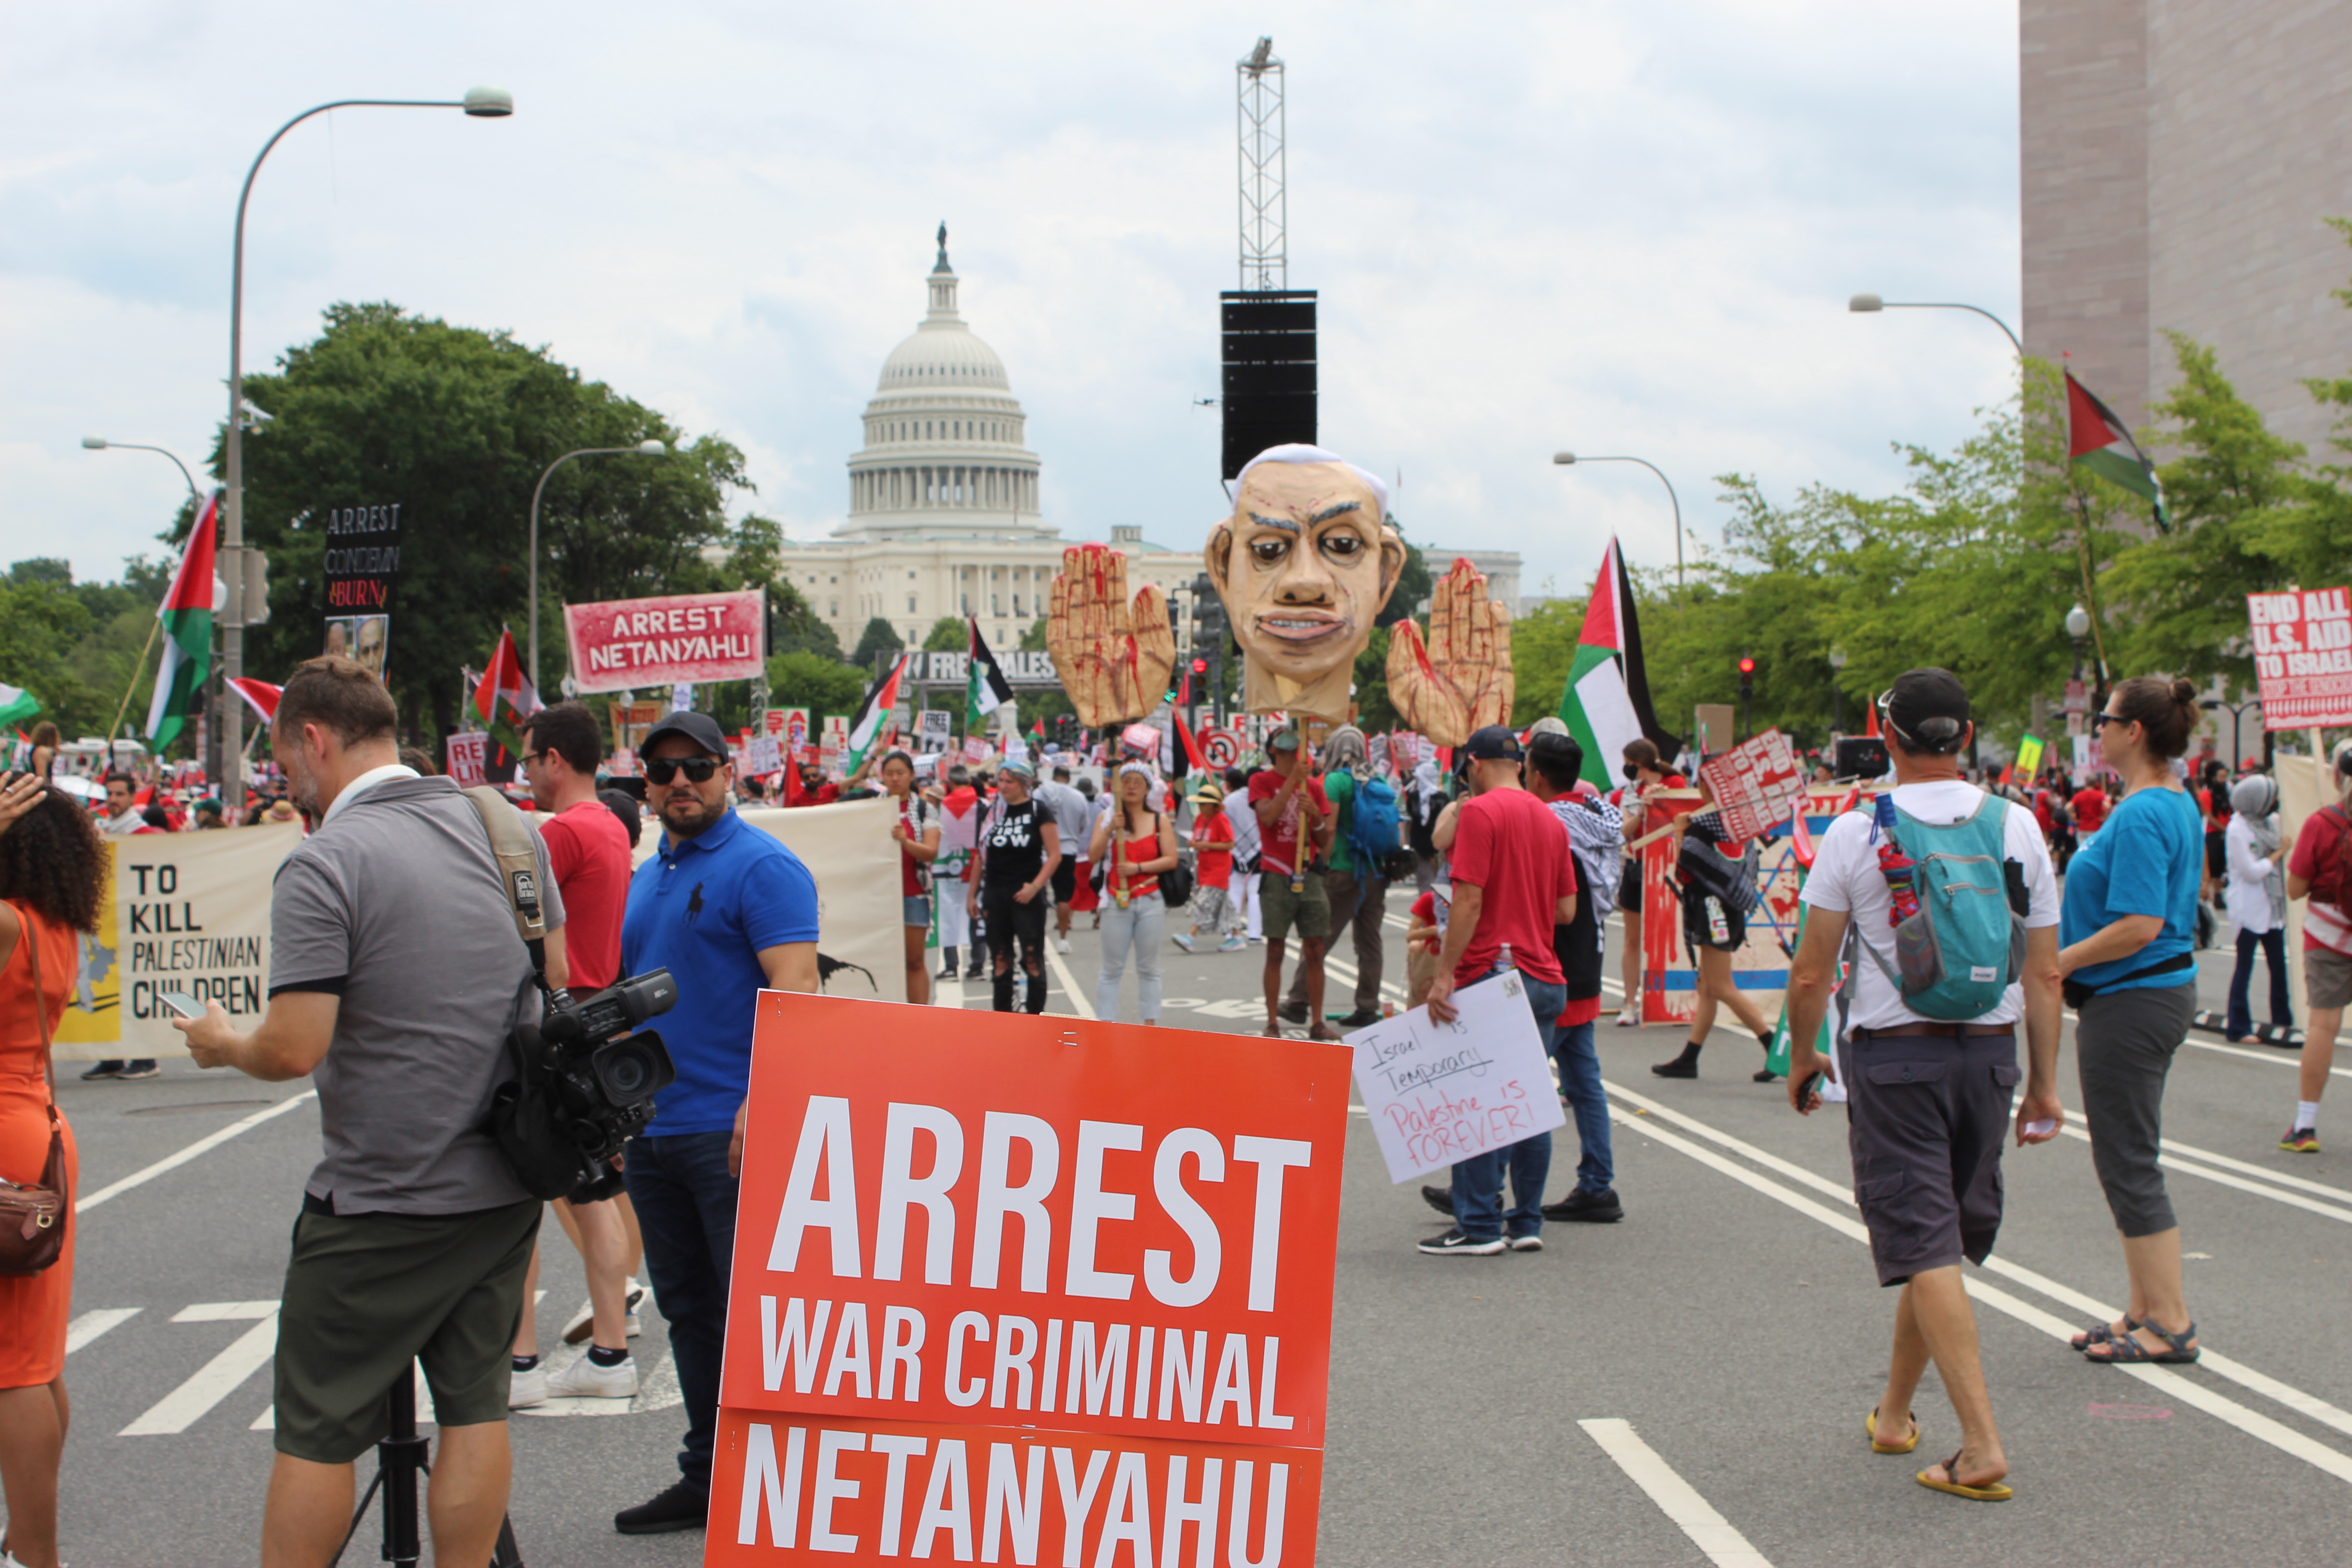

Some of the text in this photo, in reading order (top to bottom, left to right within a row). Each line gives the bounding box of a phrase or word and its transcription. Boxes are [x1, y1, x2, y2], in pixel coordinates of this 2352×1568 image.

[327, 503, 401, 534] ARREST
[335, 579, 381, 607] BURN
[2249, 589, 2351, 624] END ALL
[612, 606, 727, 638] ARREST
[2253, 620, 2352, 654] U.S. AID
[590, 634, 750, 671] NETANYAHU
[929, 652, 969, 679] FRE
[2256, 649, 2352, 679] TO ISRAEL
[453, 741, 488, 761] RE
[1729, 746, 1750, 771] TO
[1743, 738, 1772, 783] U.S.
[1759, 728, 1791, 774] END
[457, 764, 487, 781] LIN
[129, 864, 176, 895] TO
[129, 902, 202, 934] KILL
[132, 936, 261, 972] PALESTINIAN
[1361, 1021, 1468, 1070] Israel is
[1377, 1047, 1487, 1091] Temporary
[1383, 1080, 1526, 1137] Palestine is
[1406, 1103, 1535, 1168] FOREVER!
[766, 1095, 1312, 1312] ARREST
[760, 1295, 1294, 1430] WAR CRIMINAL
[737, 1423, 1289, 1568] NETANYAHU
